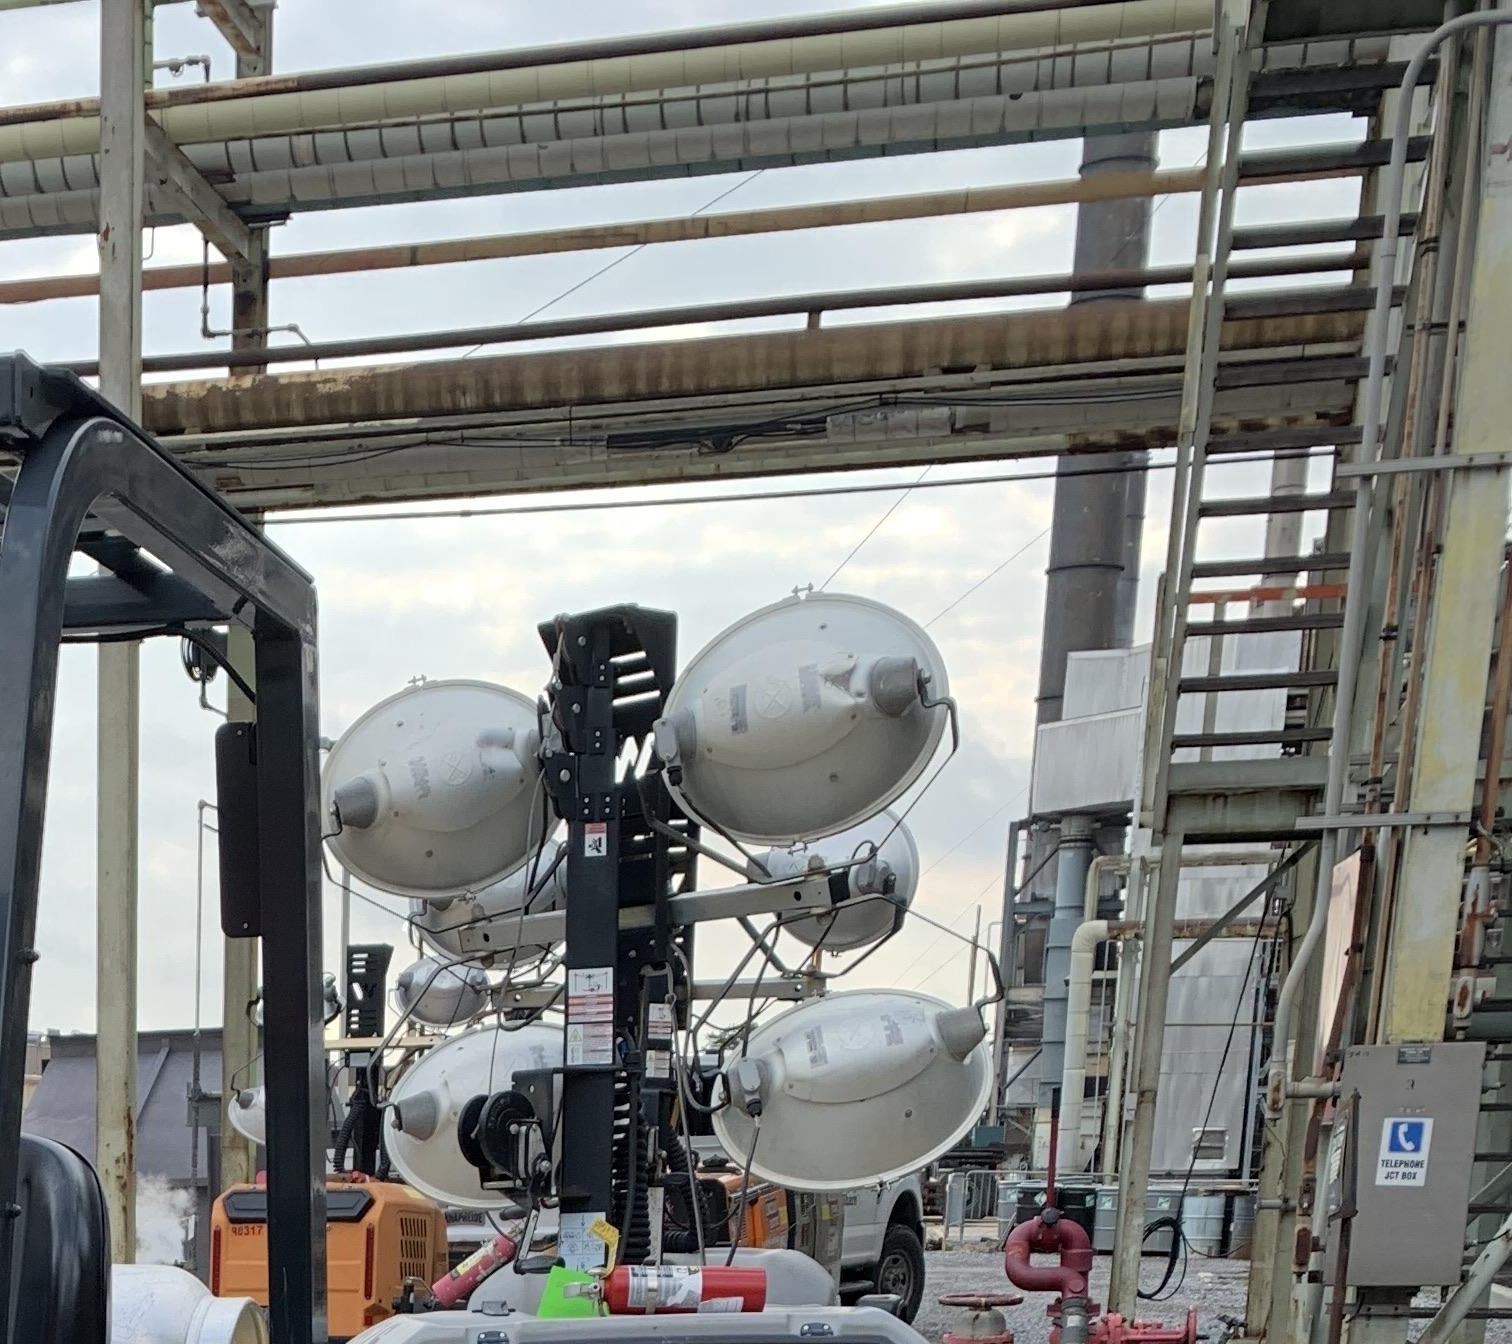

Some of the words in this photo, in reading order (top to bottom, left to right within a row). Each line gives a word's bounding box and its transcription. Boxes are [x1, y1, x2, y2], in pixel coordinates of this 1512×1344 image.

[1380, 1159, 1425, 1169] TELEPHONE
[1384, 1171, 1400, 1180] JCT
[1400, 1171, 1418, 1180] BOX
